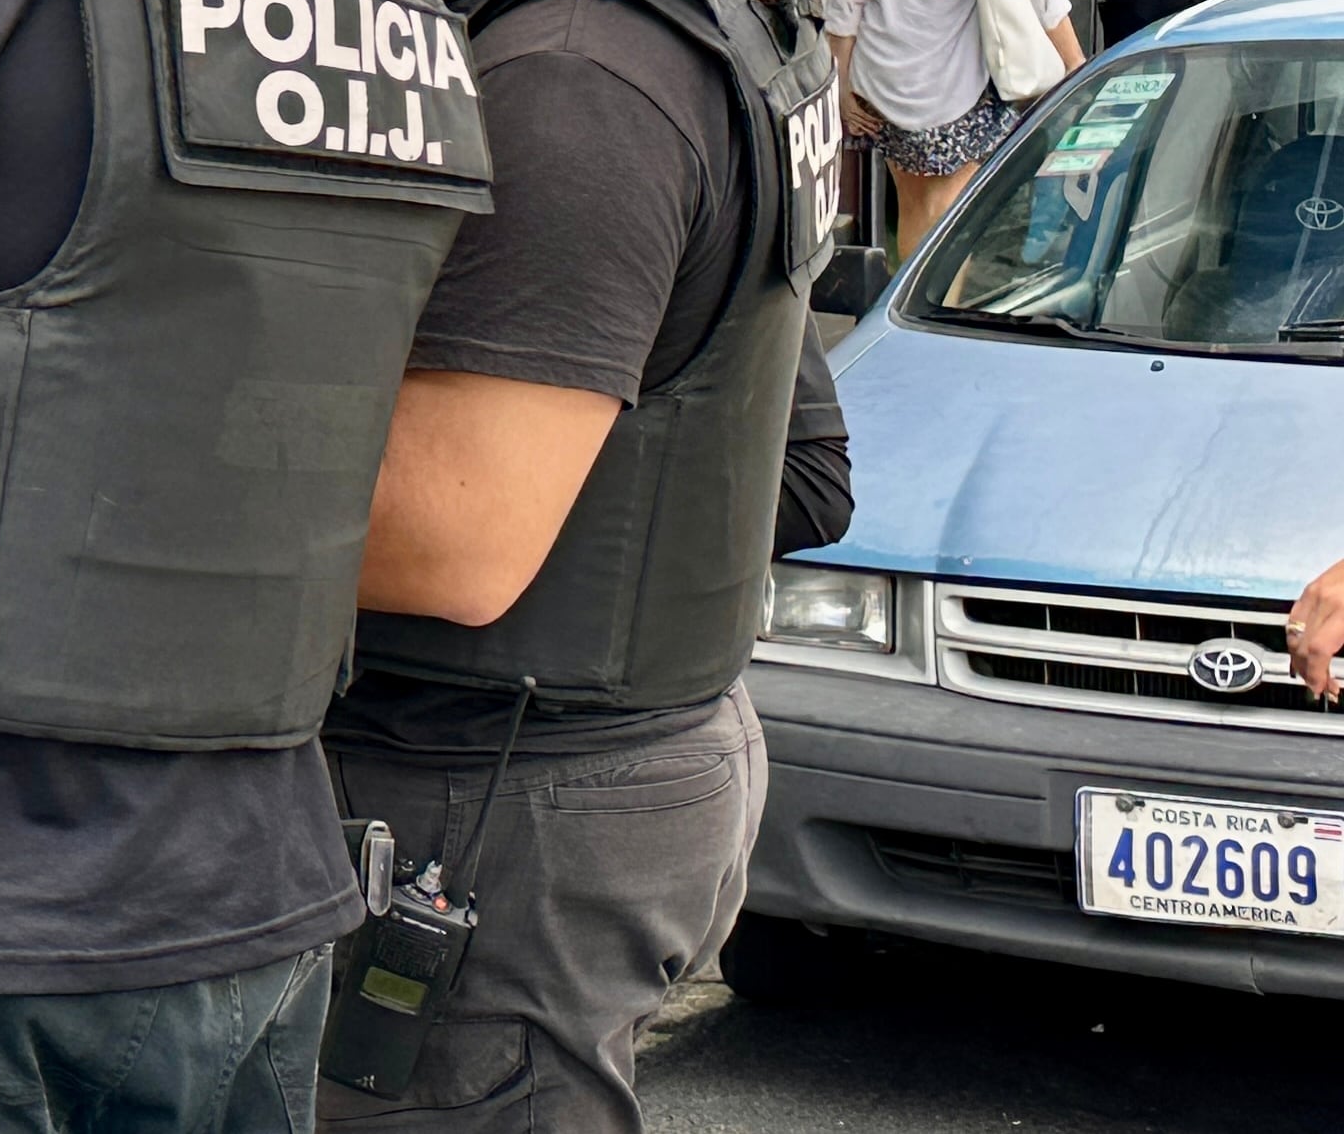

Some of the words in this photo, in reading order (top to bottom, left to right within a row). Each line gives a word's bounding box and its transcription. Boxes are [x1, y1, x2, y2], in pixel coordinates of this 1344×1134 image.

[256, 70, 443, 165] O.I.J.
[1151, 807, 1217, 829] COSTA
[1226, 815, 1274, 835] RICA
[1108, 827, 1318, 906] 402609
[1129, 895, 1298, 926] CENTROAMERICA
